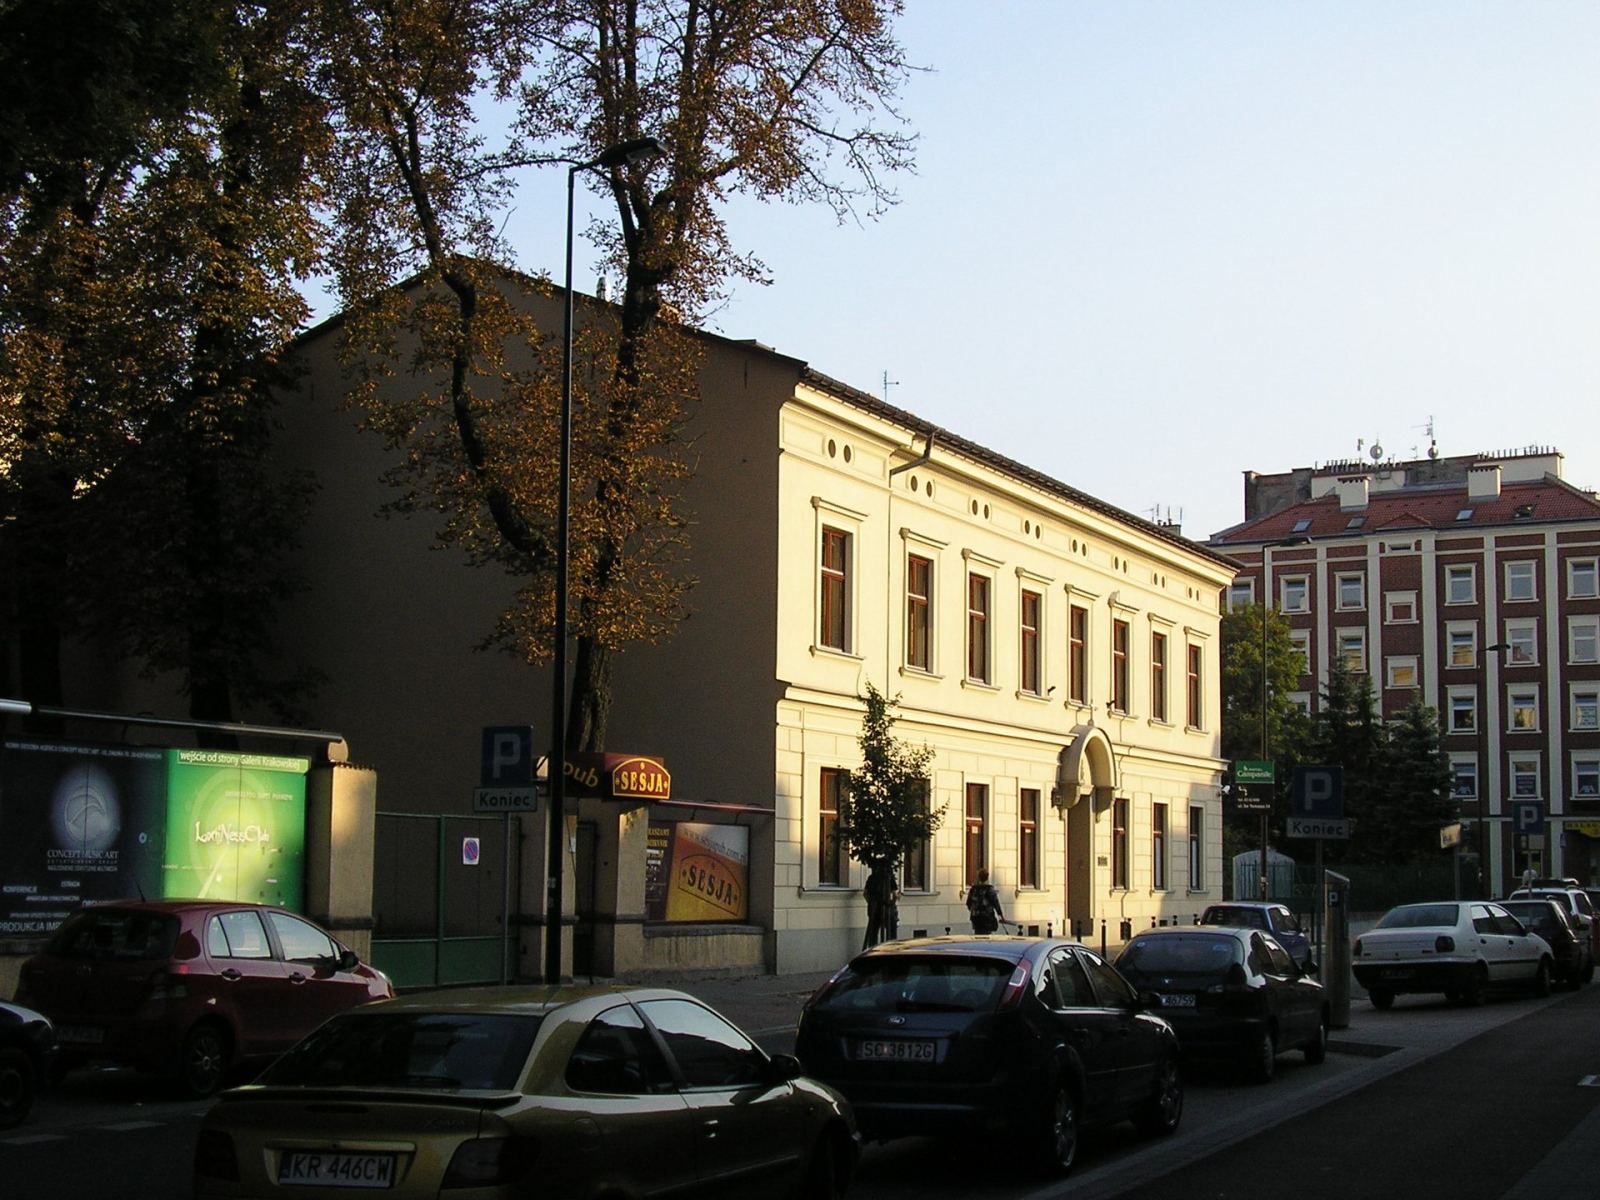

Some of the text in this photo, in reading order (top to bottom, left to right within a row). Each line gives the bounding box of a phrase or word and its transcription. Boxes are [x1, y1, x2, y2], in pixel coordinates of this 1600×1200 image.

[180, 751, 206, 763] wejście
[207, 752, 217, 763] od
[218, 754, 239, 766] strony
[493, 732, 521, 778] P
[620, 771, 663, 793] SESJA
[480, 792, 530, 807] Koniec
[1304, 772, 1333, 811] P
[1520, 805, 1538, 830] P
[1293, 821, 1344, 836] Koniec
[104, 850, 119, 859] ART
[688, 865, 732, 906] SESJA
[1329, 892, 1339, 906] P
[864, 1042, 882, 1057] SC
[293, 1155, 390, 1180] KR 446CW
